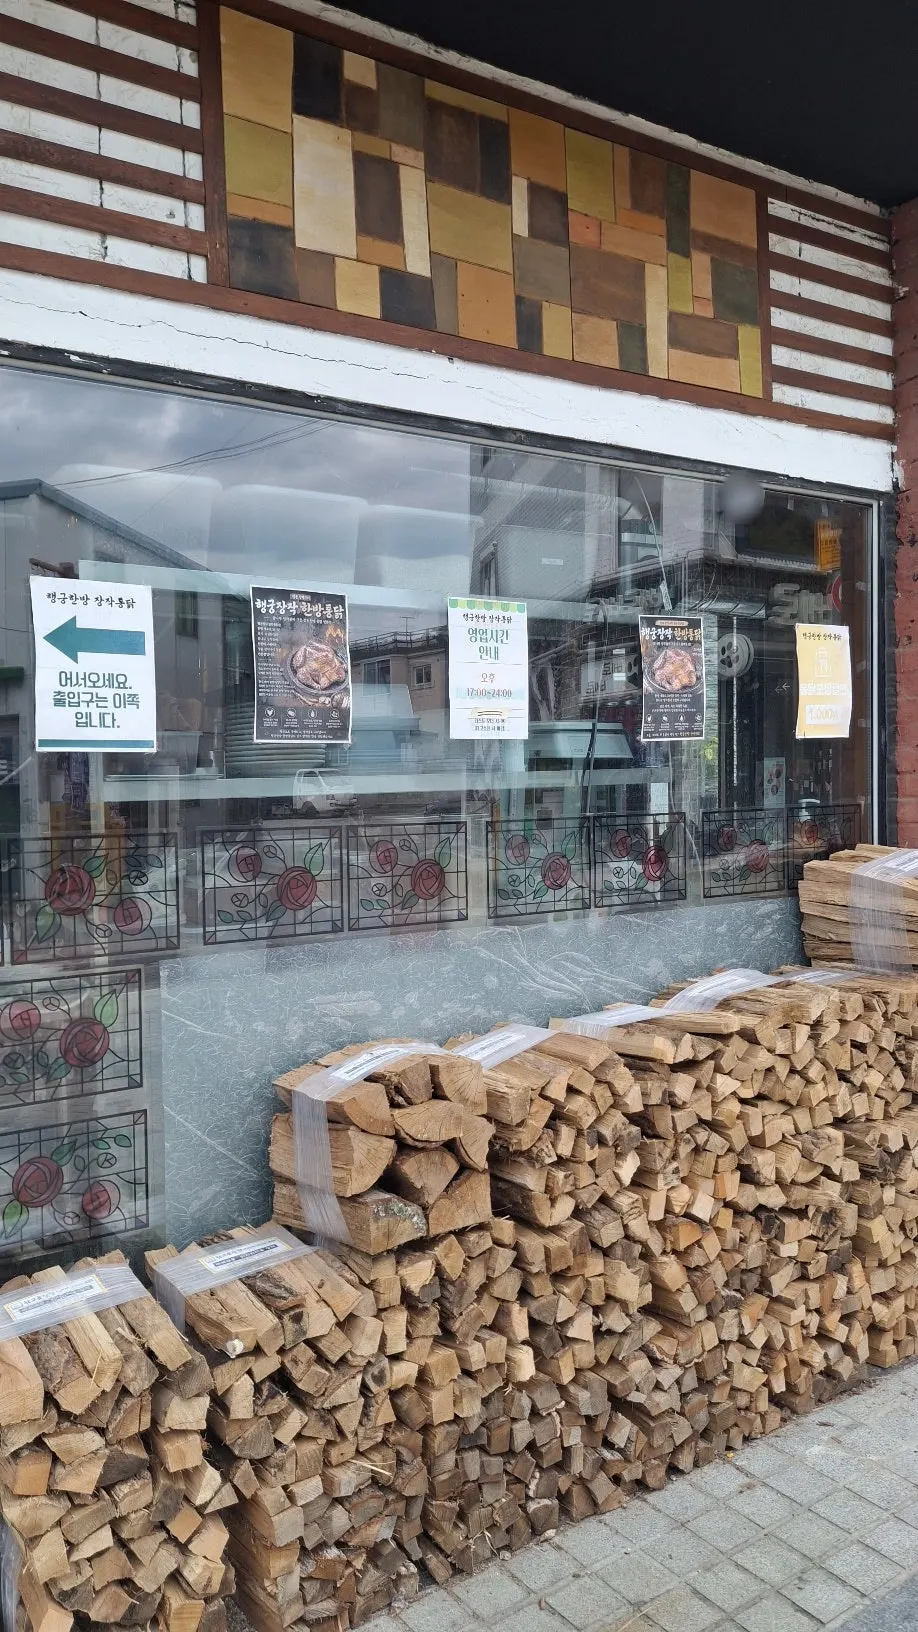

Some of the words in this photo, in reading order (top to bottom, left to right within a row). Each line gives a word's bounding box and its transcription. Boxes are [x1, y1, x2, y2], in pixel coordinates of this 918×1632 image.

[46, 591, 90, 606] 행궁한방
[94, 595, 137, 609] 장작통닭
[255, 598, 298, 615] 행궁장작
[300, 602, 344, 619] 한방통닭
[467, 627, 509, 644] 영업시간
[640, 626, 673, 640] 행궁장작
[673, 627, 702, 641] 한방통닭
[478, 645, 500, 661] 안내
[58, 670, 133, 690] 어서오세요.
[481, 672, 495, 683] 오후
[52, 690, 108, 709] 출입구는
[112, 692, 140, 710] 이쪽
[74, 711, 121, 729] 입니다.
